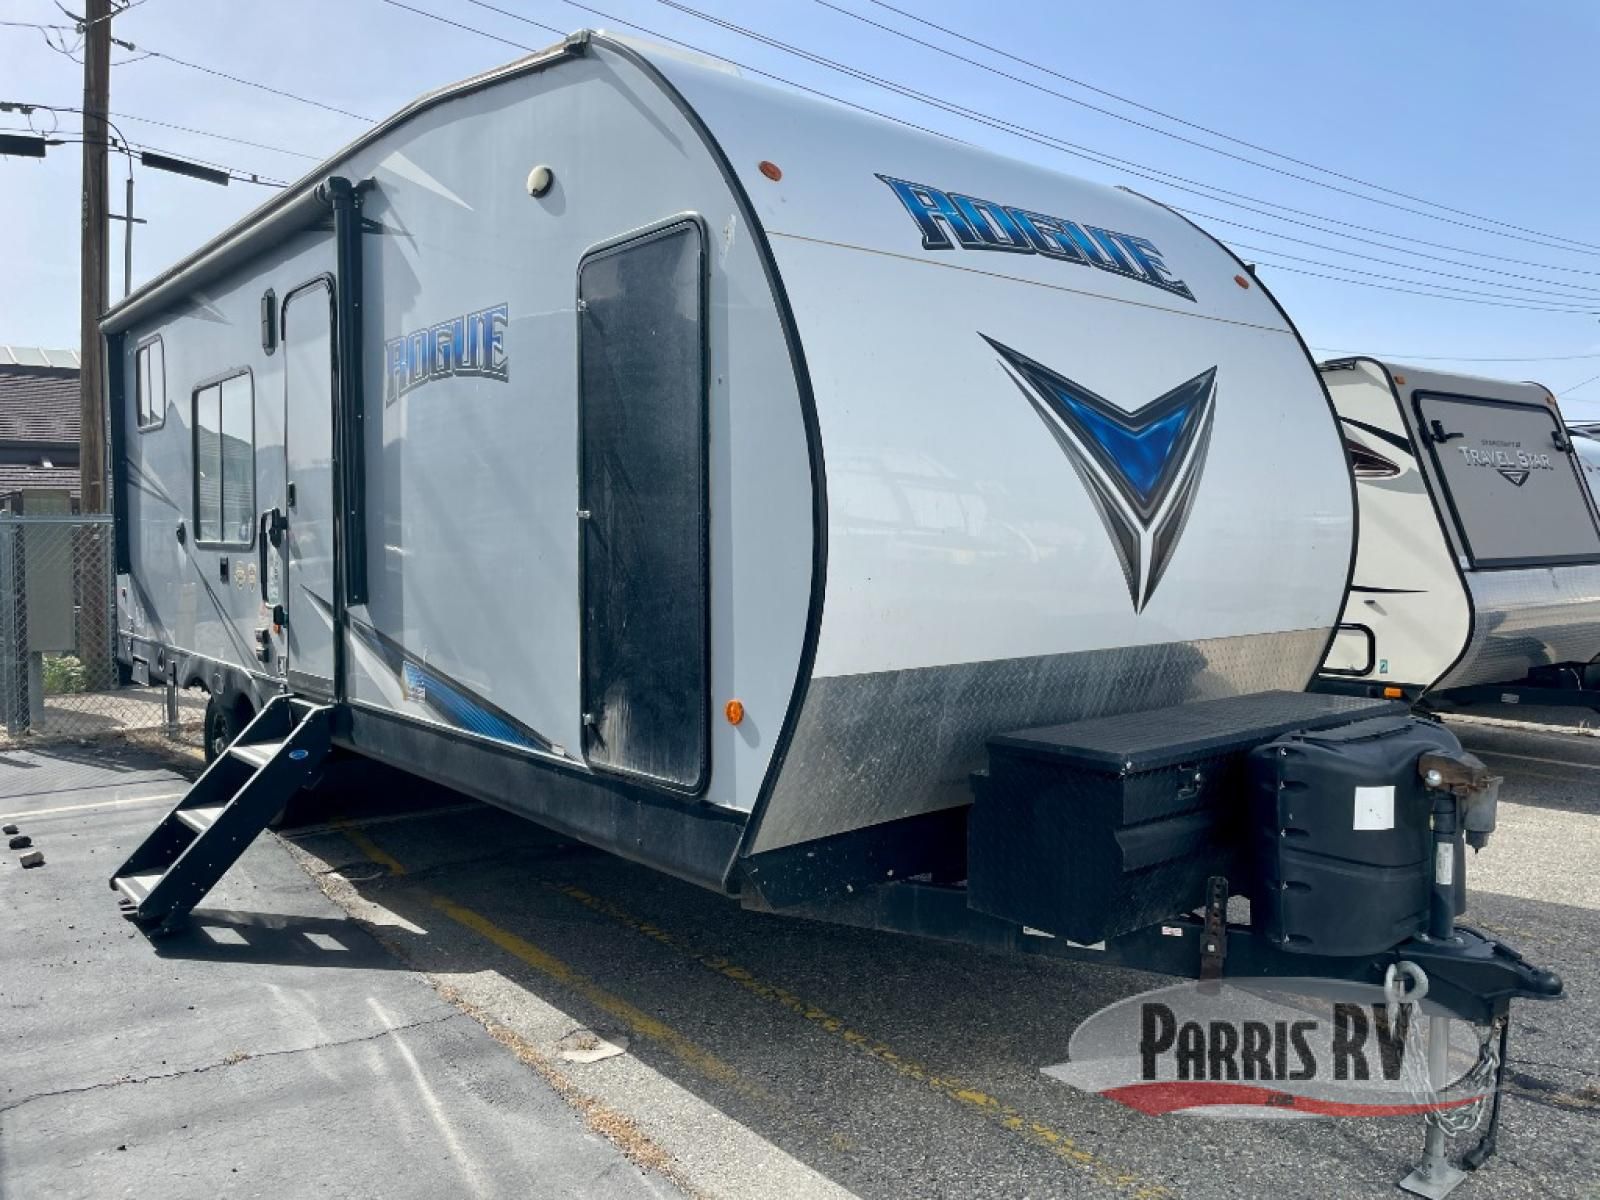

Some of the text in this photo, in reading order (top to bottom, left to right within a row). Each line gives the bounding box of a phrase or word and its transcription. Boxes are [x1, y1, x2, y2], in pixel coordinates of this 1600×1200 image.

[874, 172, 1198, 303] ROGUE
[384, 302, 509, 408] ROGUE
[1458, 446, 1554, 470] TRAVEL STAR
